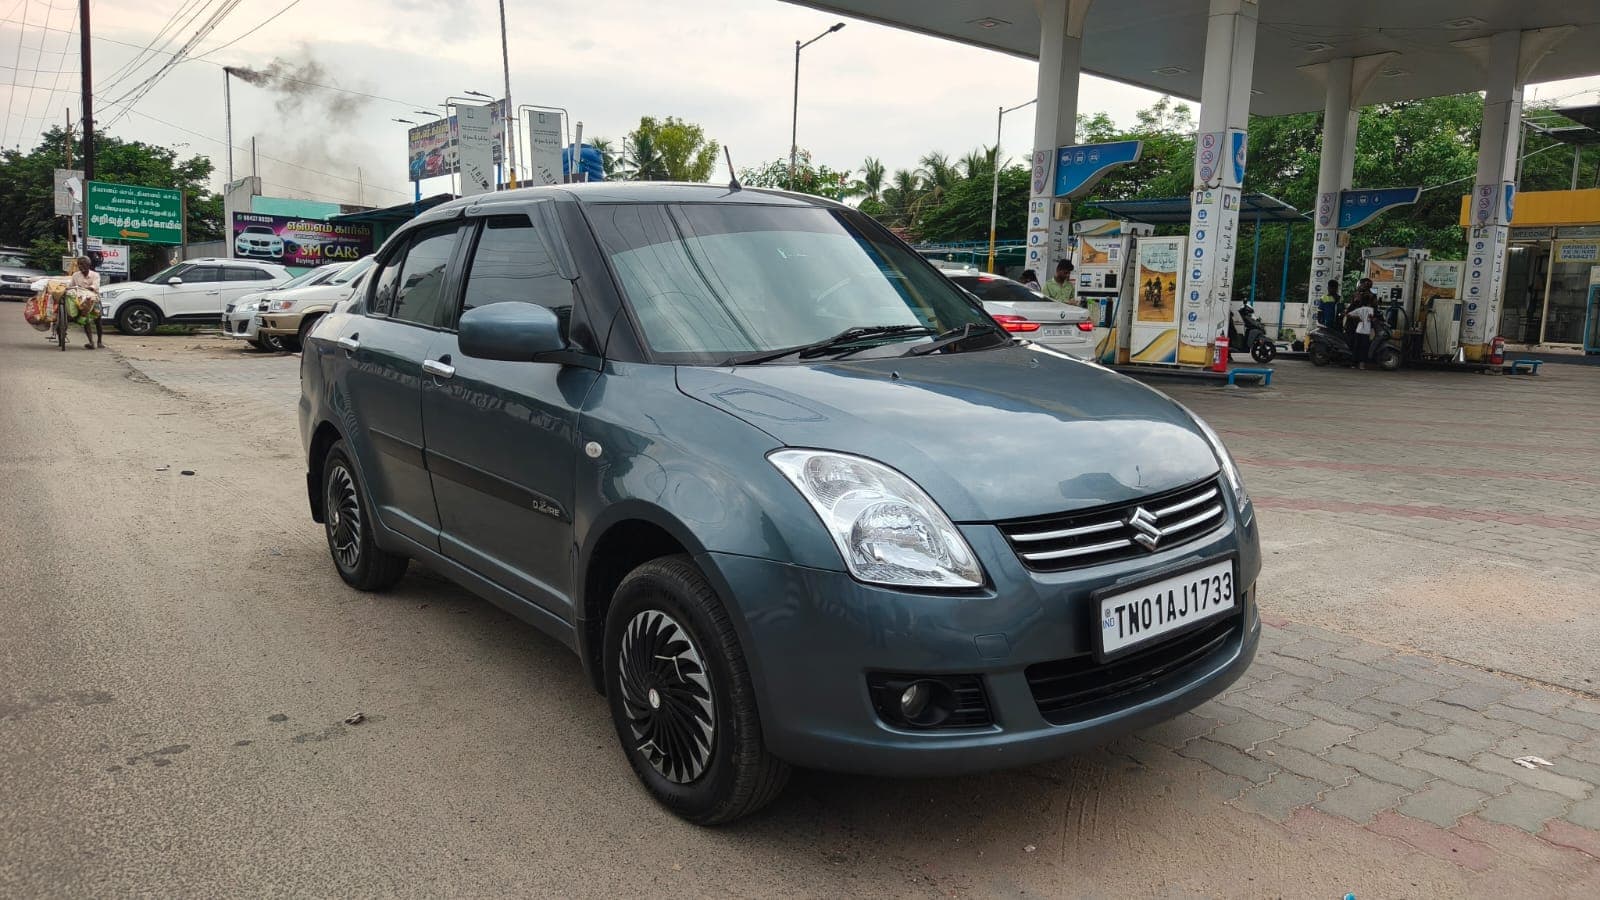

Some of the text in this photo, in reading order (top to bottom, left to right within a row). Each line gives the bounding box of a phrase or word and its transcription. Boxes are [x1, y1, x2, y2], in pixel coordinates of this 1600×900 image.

[1062, 175, 1067, 186] 1
[300, 243, 360, 259] SM CARS
[1115, 572, 1232, 639] TN01AJ1733
